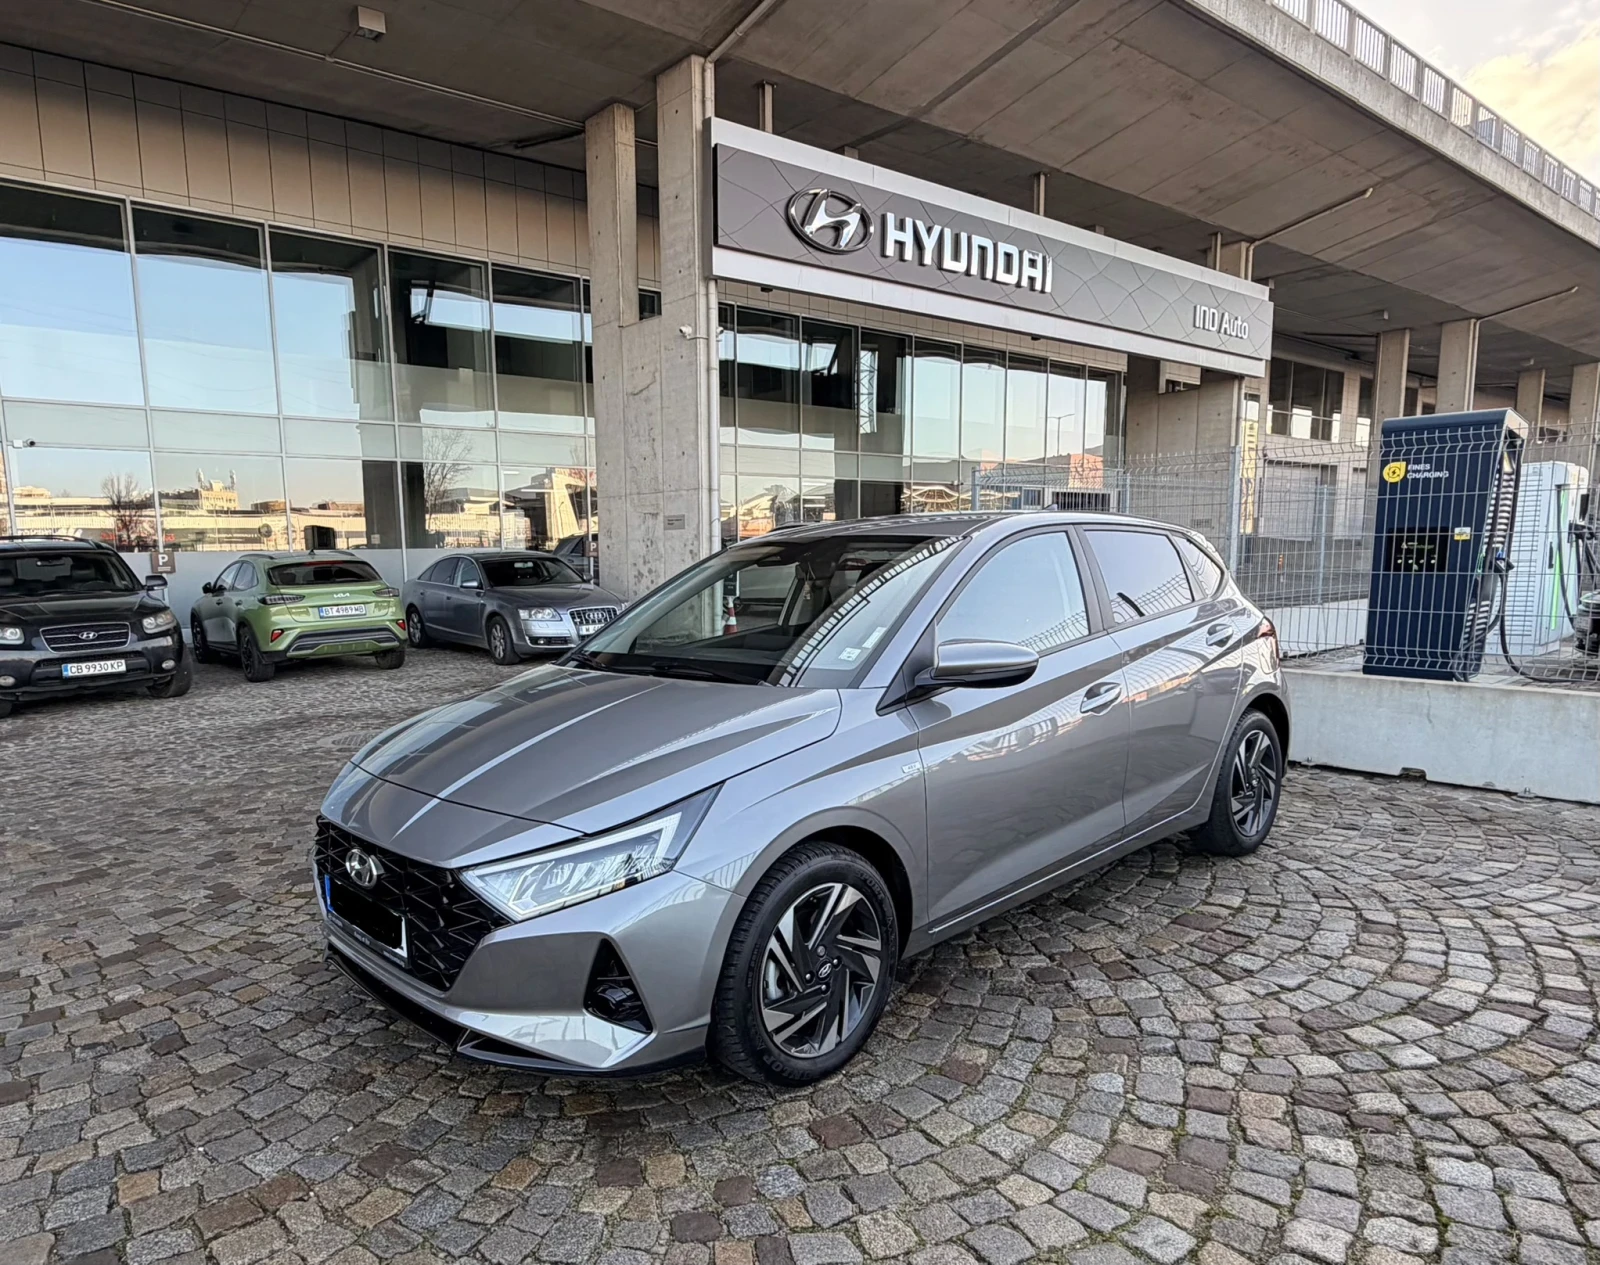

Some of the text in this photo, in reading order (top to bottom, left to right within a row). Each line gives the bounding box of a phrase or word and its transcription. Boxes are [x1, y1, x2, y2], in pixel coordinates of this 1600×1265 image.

[883, 212, 1053, 293] HYUNDAI
[1194, 304, 1249, 339] IND Auto
[1406, 470, 1449, 479] CHARGING
[590, 542, 597, 552] P
[158, 554, 169, 566] P
[324, 607, 334, 615] BT
[69, 661, 123, 674] CB 9930 KP
